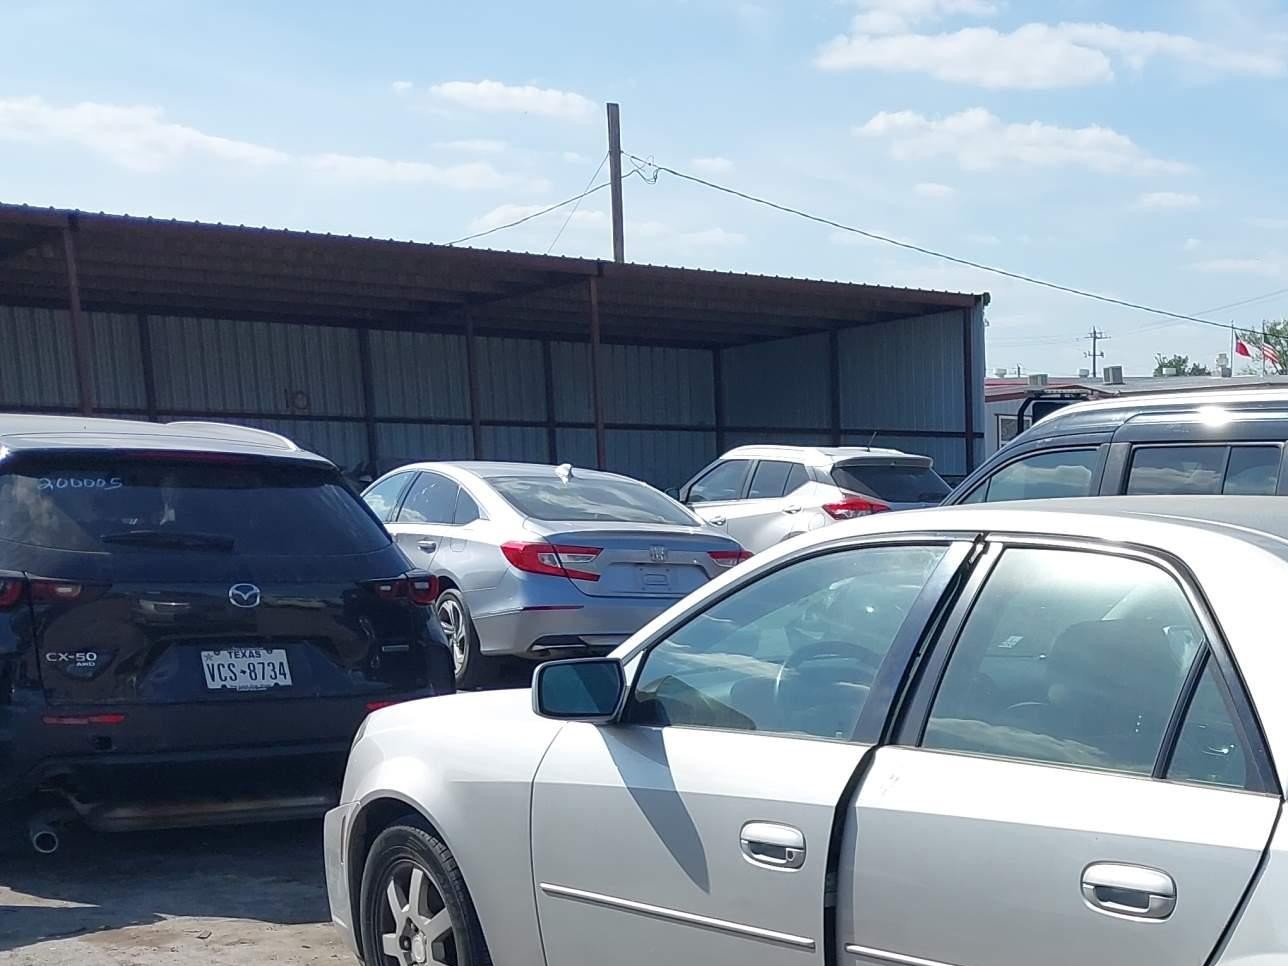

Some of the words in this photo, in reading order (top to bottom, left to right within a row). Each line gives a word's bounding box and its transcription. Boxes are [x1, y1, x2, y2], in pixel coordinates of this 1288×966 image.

[46, 652, 97, 662] CX-50
[227, 649, 262, 659] TEXAS
[206, 662, 238, 682] VCS
[247, 661, 287, 681] 8734
